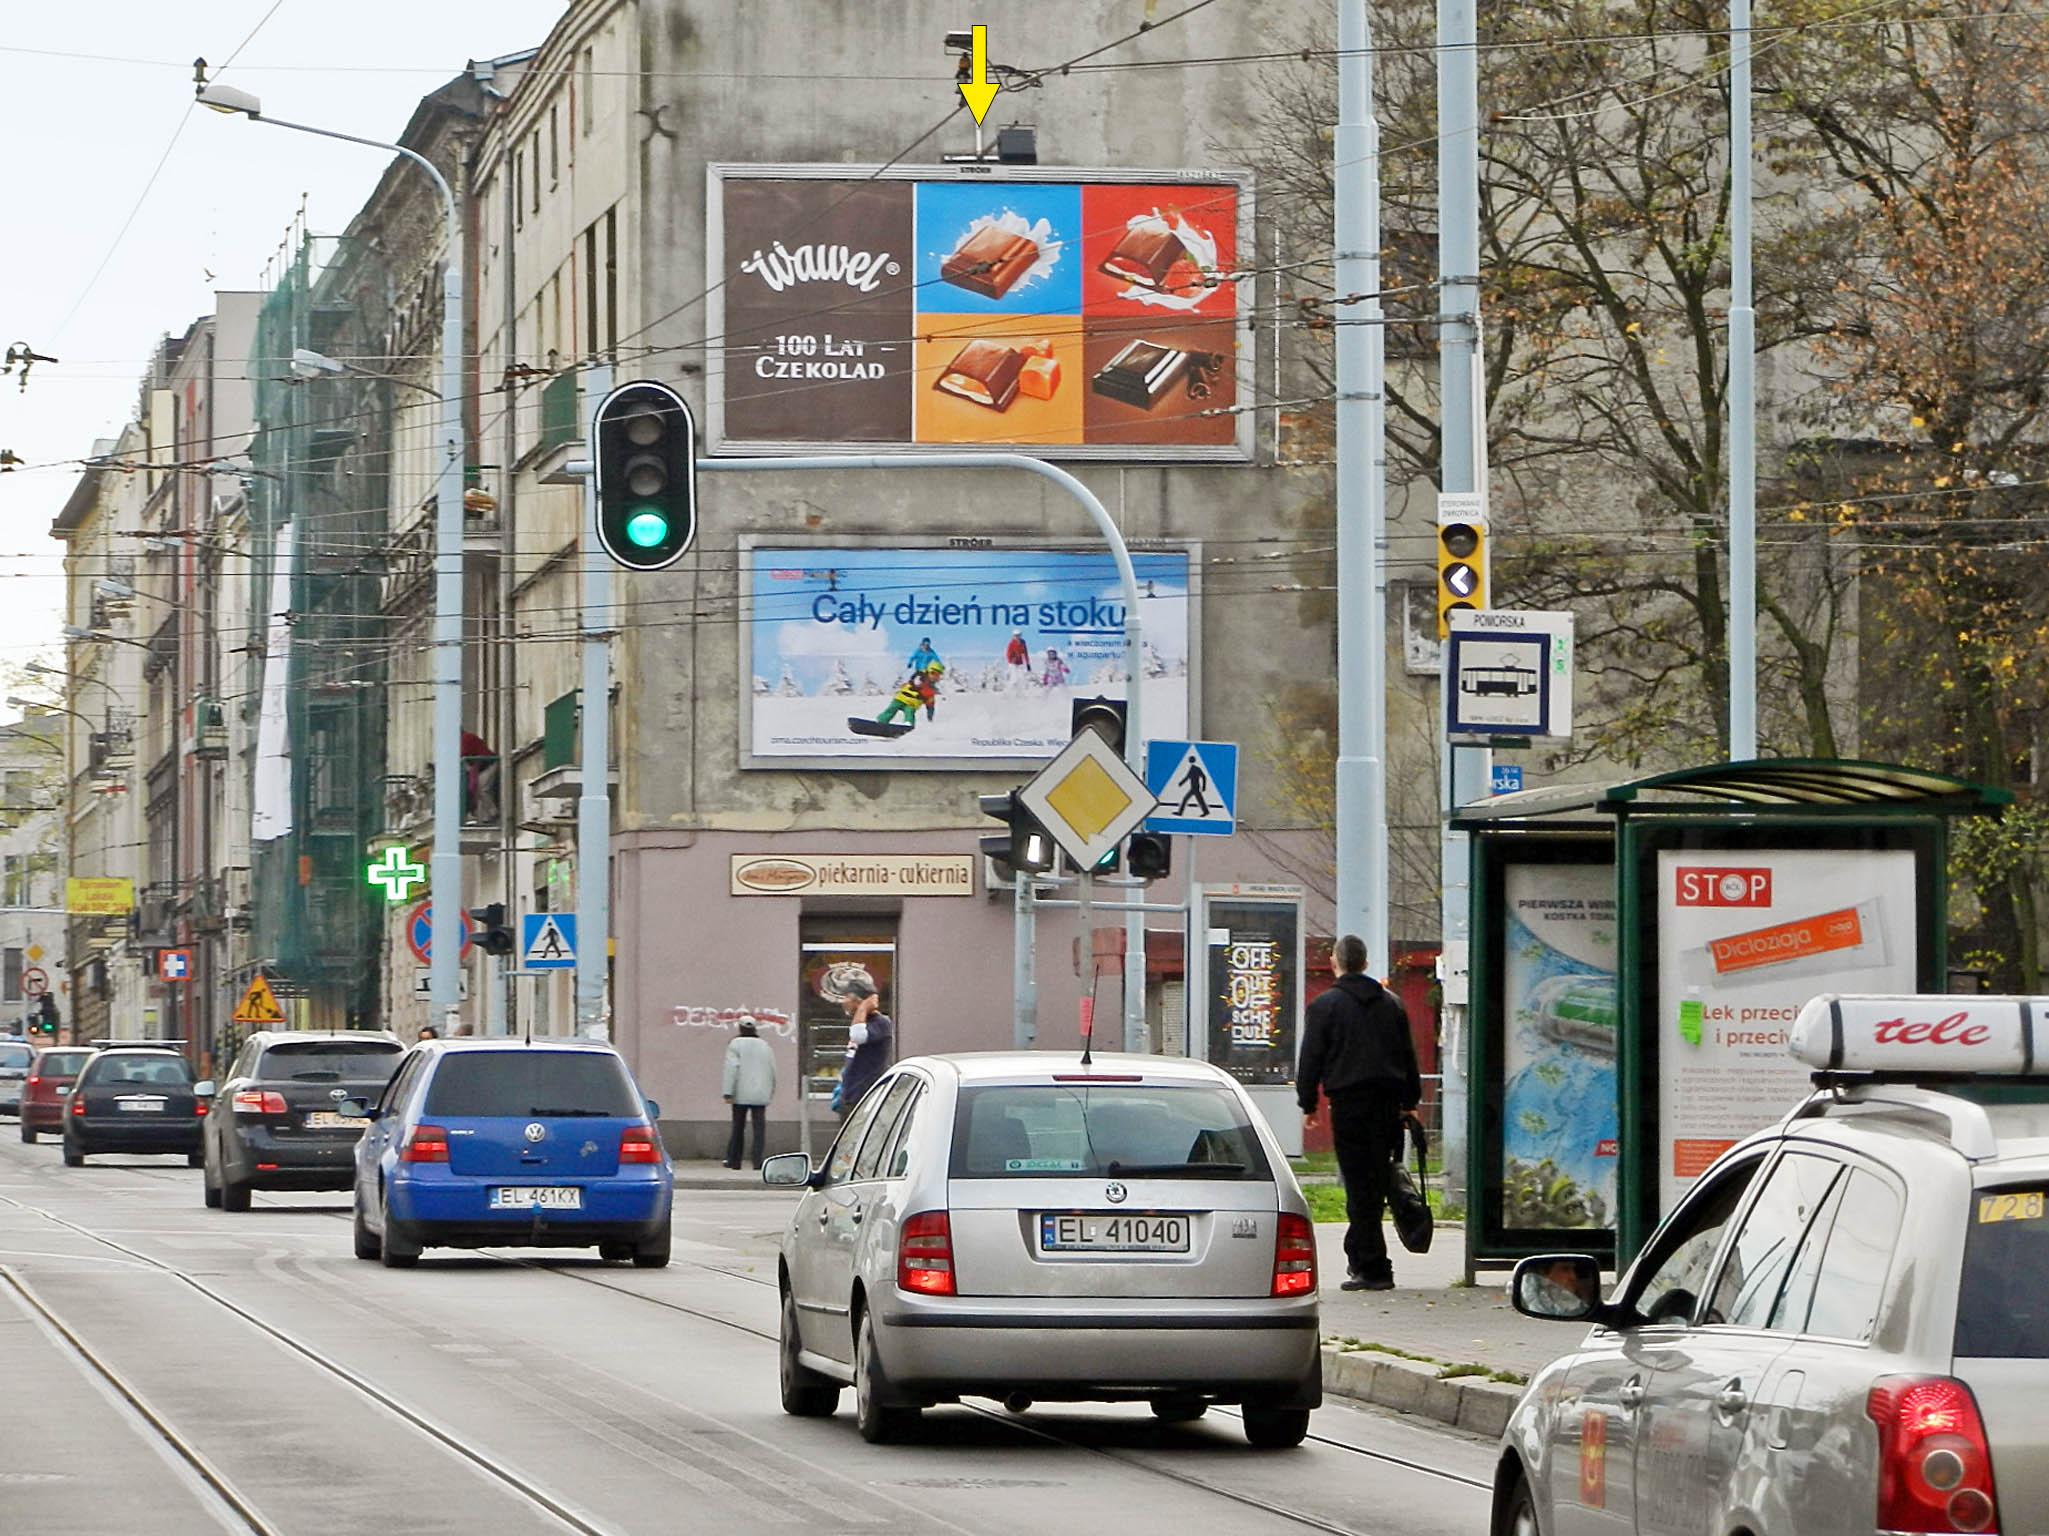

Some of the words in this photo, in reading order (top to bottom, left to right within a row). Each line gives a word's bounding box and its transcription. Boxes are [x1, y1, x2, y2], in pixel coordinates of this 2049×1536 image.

[775, 335, 817, 356] 100
[755, 356, 886, 379] CZEKOLAD
[811, 594, 885, 630] Cały
[894, 595, 983, 626] dzień
[991, 607, 1031, 627] na
[1038, 596, 1126, 627] stoku
[1474, 614, 1526, 628] POMORSKA
[1682, 873, 1767, 902] STOP
[1232, 947, 1272, 969] OFF
[1702, 1005, 1734, 1020] Lek
[1873, 1011, 1992, 1046] tele
[501, 1188, 523, 1203] EL
[529, 1188, 578, 1204] 461KX
[1058, 1219, 1093, 1242] EL
[1105, 1219, 1181, 1244] 41040
